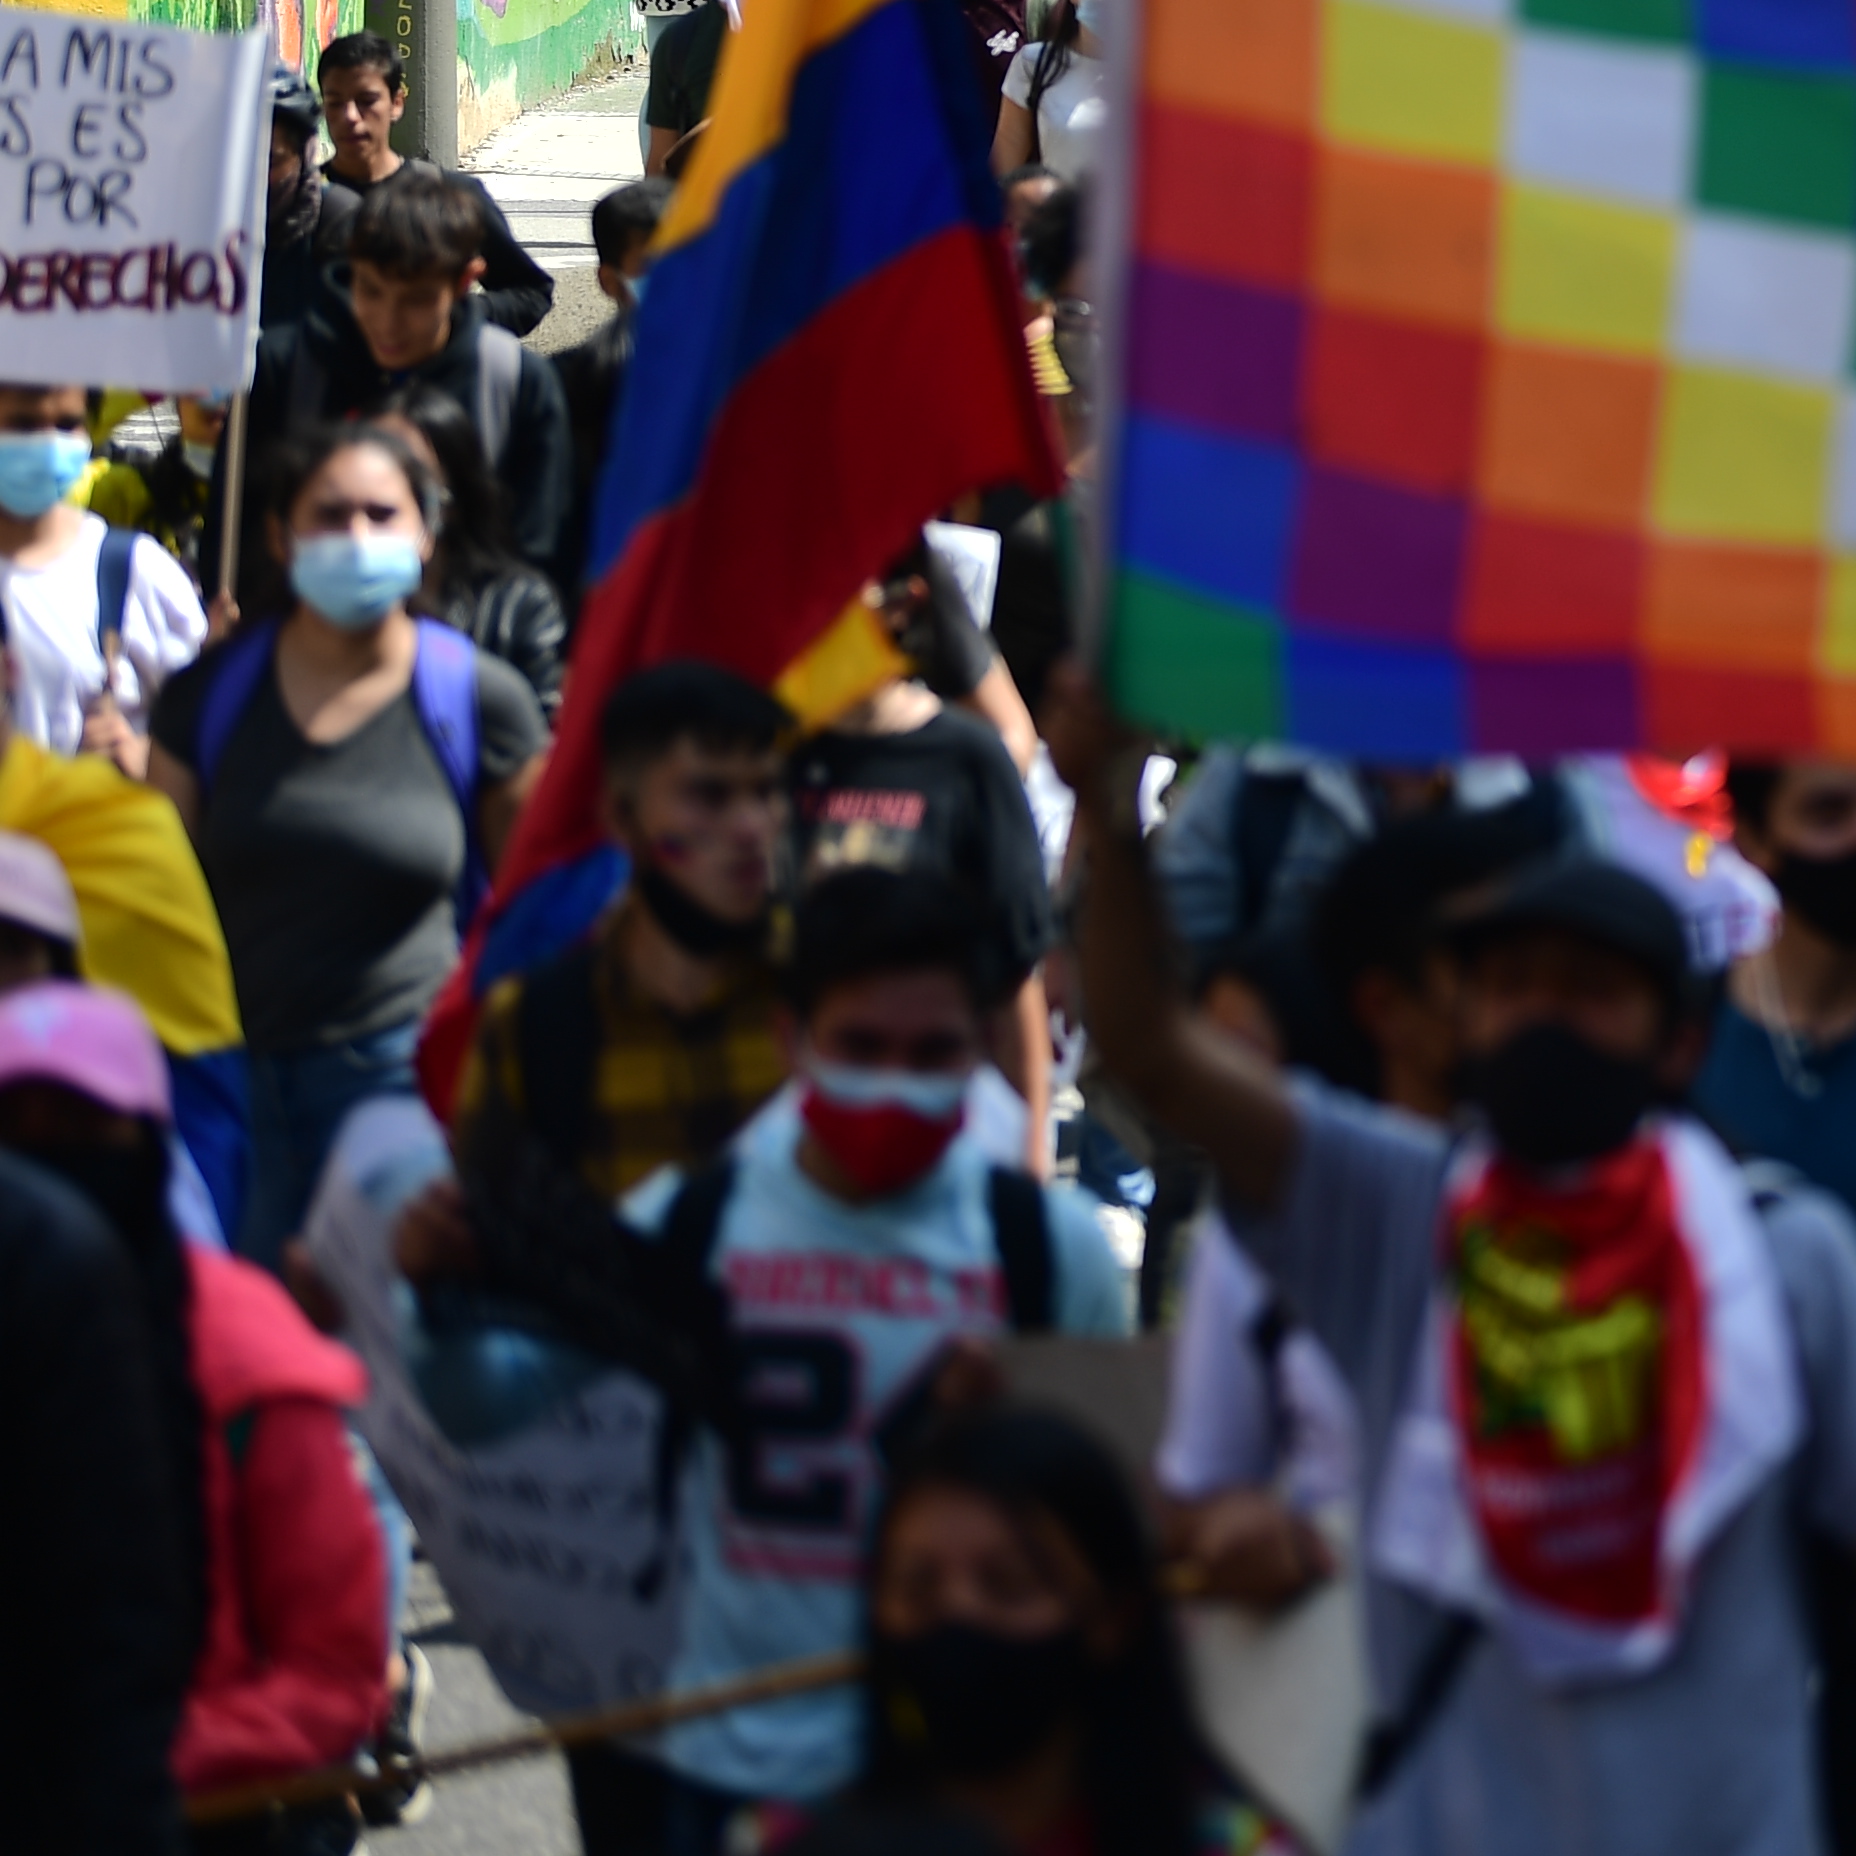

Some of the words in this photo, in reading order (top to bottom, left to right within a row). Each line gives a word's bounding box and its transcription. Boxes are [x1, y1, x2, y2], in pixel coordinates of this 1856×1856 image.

[0, 25, 40, 89] A
[61, 25, 175, 98] MIS
[72, 102, 148, 163] ES
[24, 157, 139, 228] POR
